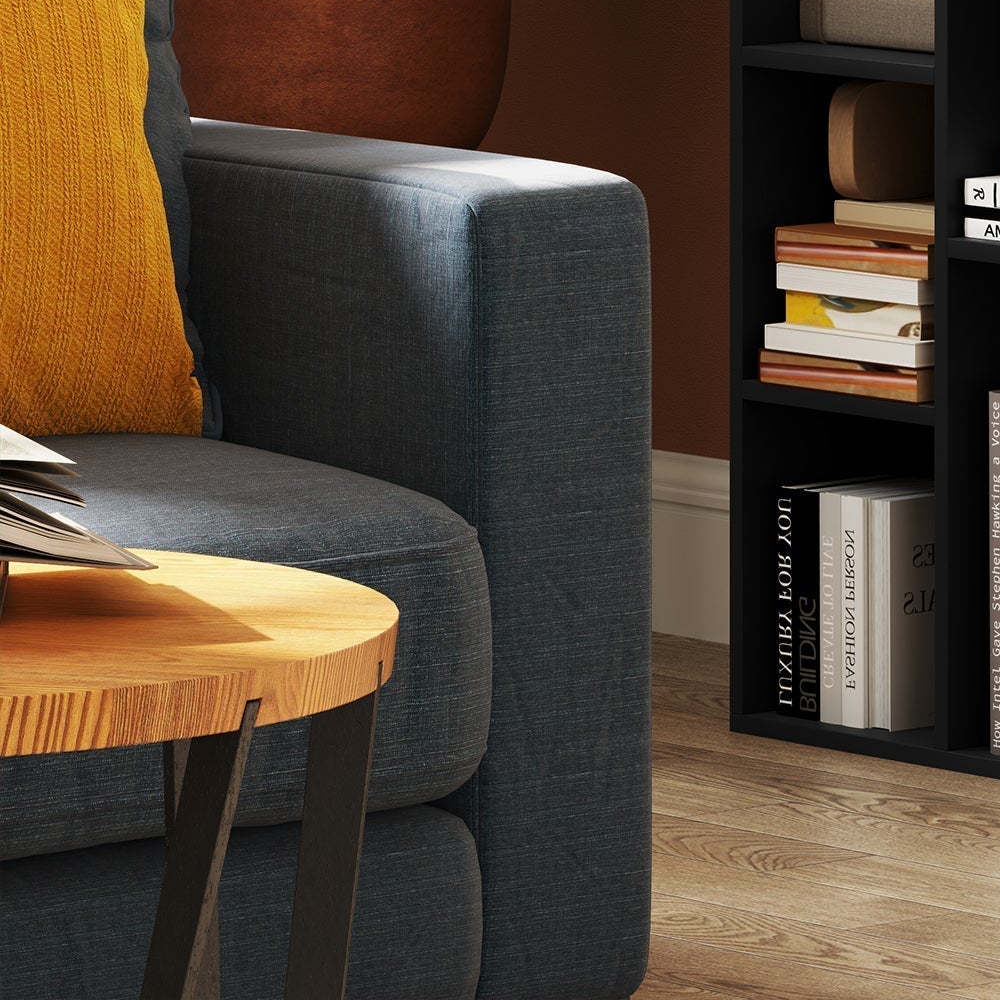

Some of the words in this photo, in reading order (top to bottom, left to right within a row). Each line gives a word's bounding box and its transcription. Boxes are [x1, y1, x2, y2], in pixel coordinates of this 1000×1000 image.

[991, 401, 1000, 447] Voice
[992, 456, 1000, 465] a
[992, 620, 1000, 657] Gave
[992, 667, 1000, 711] Intel
[993, 720, 1000, 748] How
